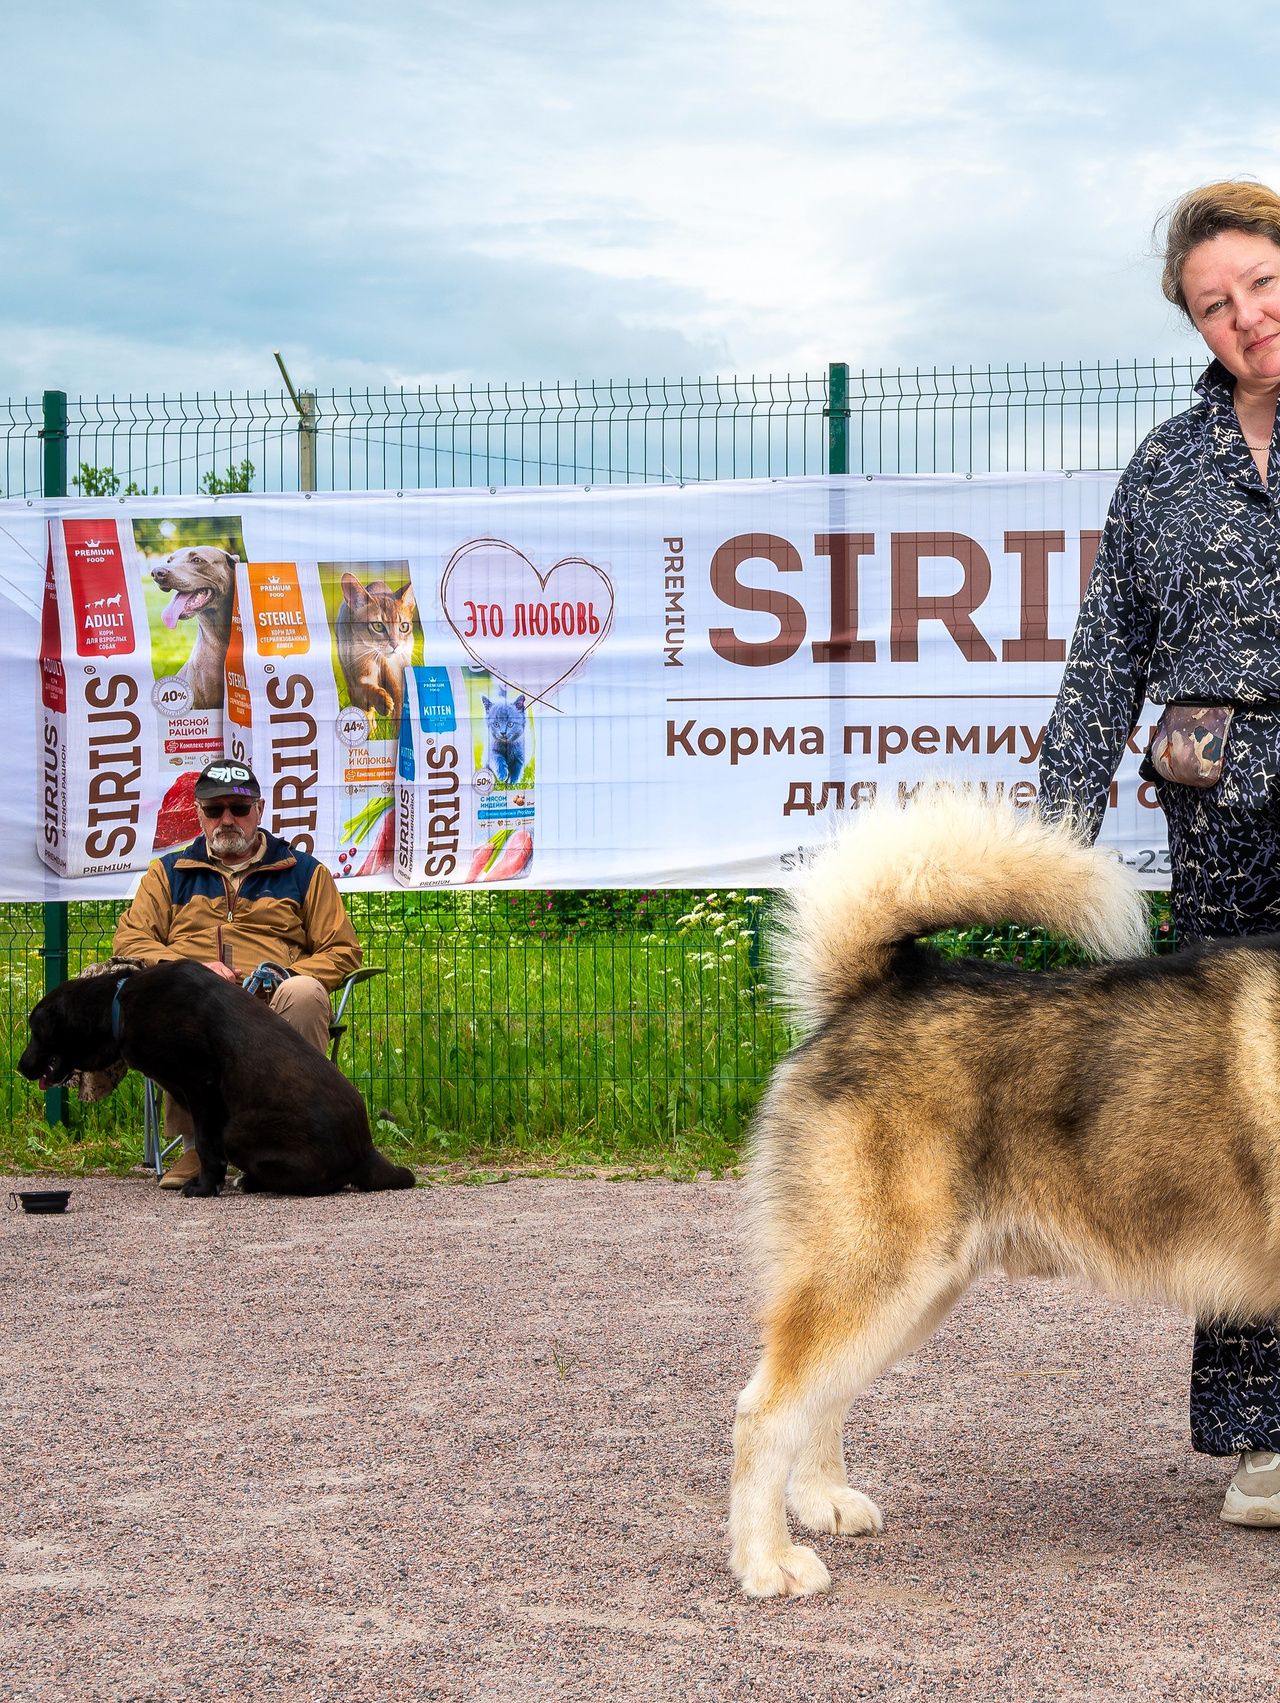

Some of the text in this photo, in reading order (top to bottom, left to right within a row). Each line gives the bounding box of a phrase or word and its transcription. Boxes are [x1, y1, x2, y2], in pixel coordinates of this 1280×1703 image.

[74, 548, 115, 557] PREMIUM
[663, 537, 684, 667] PREMIUM
[708, 529, 1101, 666] SIRI
[84, 613, 125, 629] ADULT
[258, 611, 303, 627] STERILE
[464, 600, 600, 638] ЭТО ЛЮБОВЬ
[228, 671, 248, 690] STERIL
[161, 691, 187, 703] 40%
[423, 705, 451, 716] KITTEN
[168, 717, 209, 727] МЯСНОЙ
[343, 721, 365, 733] 44%
[169, 728, 208, 737] РАЦИОН
[666, 719, 1047, 765] Корма премиу
[348, 749, 369, 757] УТКА
[356, 757, 392, 765] КЛЮКВА
[85, 674, 141, 859] SIRIUS
[44, 724, 59, 848] SIRIUS
[783, 780, 878, 817] для
[424, 745, 460, 876] SIRIUS
[400, 788, 410, 868] SIRIUS
[84, 862, 132, 875] PREMIUM
